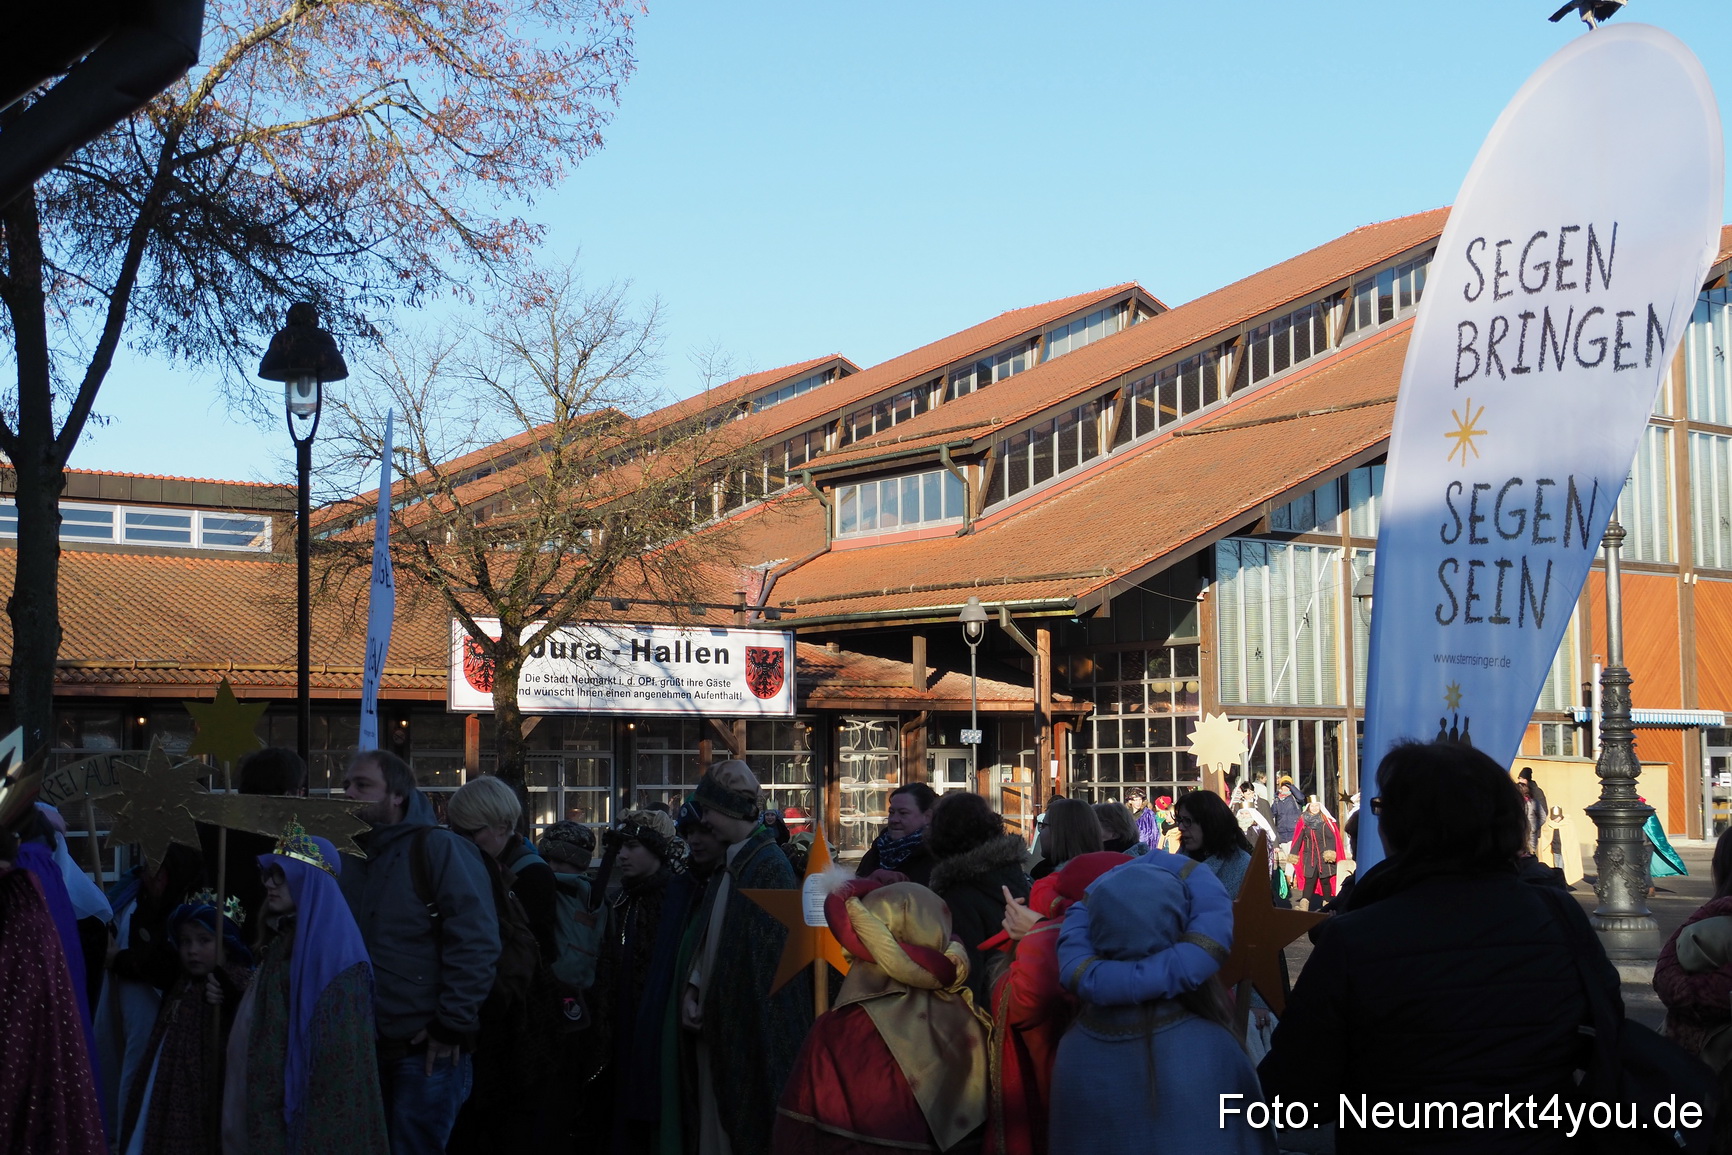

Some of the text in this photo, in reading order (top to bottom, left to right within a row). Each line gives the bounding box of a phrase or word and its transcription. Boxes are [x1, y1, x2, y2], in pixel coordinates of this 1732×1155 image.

[1463, 221, 1618, 302] SEGEN
[1454, 302, 1667, 390] BRINGEN
[1440, 474, 1599, 550] SEGEN
[1435, 555, 1553, 630] SEIN
[530, 640, 601, 660] Jura
[631, 638, 729, 664] Hallen
[1433, 653, 1512, 670] www.sternsinger.de
[518, 686, 743, 701] nd wünscht Ihnen einen angenehmen Aufenthalt!
[525, 673, 541, 683] Die
[543, 674, 568, 684] Stadt
[571, 674, 616, 686] Neumarkt
[627, 677, 635, 686] d.
[660, 678, 684, 689] grüßt
[686, 678, 703, 688] ihre
[706, 678, 731, 688] Gäste
